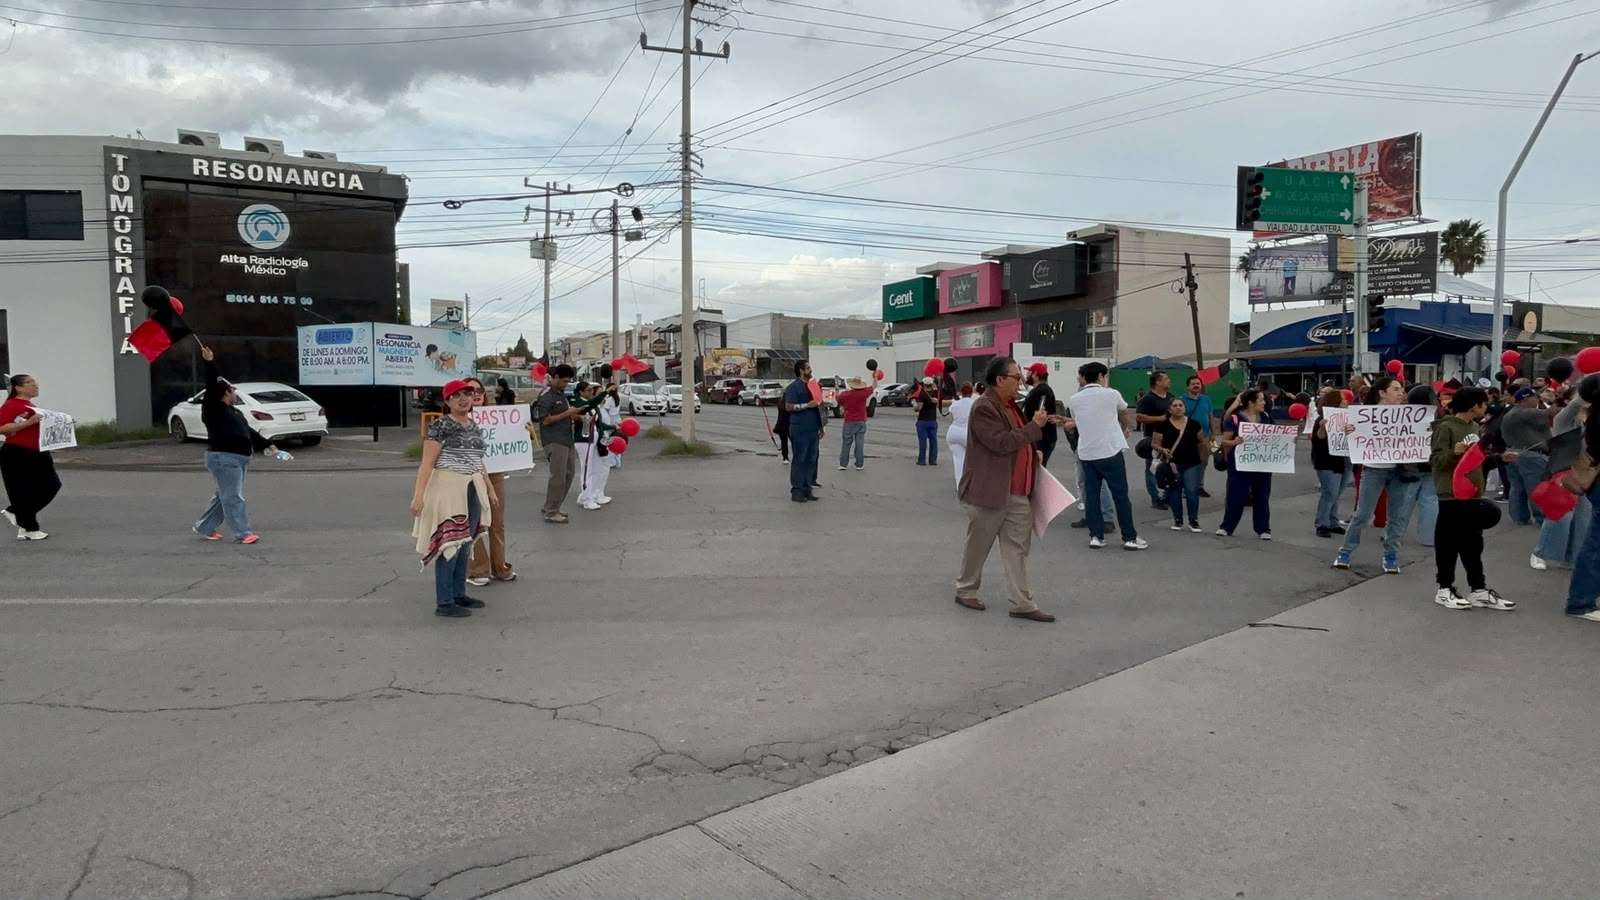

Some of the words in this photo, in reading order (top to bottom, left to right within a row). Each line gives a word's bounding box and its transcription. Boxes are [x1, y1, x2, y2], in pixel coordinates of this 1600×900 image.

[192, 157, 364, 191] RESONANCIA
[1267, 223, 1298, 231] VIALIDAD
[1300, 224, 1309, 232] LA
[1310, 224, 1342, 232] CANTERA
[220, 254, 247, 264] Alta
[249, 255, 309, 269] Radiología
[244, 264, 286, 276] México
[376, 339, 421, 349] RESONANCIA
[303, 348, 310, 357] DE
[335, 346, 368, 355] DOMINGO
[385, 355, 413, 363] ABIERTA
[1358, 406, 1427, 424] SEGURO
[480, 428, 496, 440] DE
[1241, 424, 1298, 436] EXIGIMOS
[1372, 424, 1415, 436] SOCIAL
[1362, 449, 1428, 460] NACIONAL
